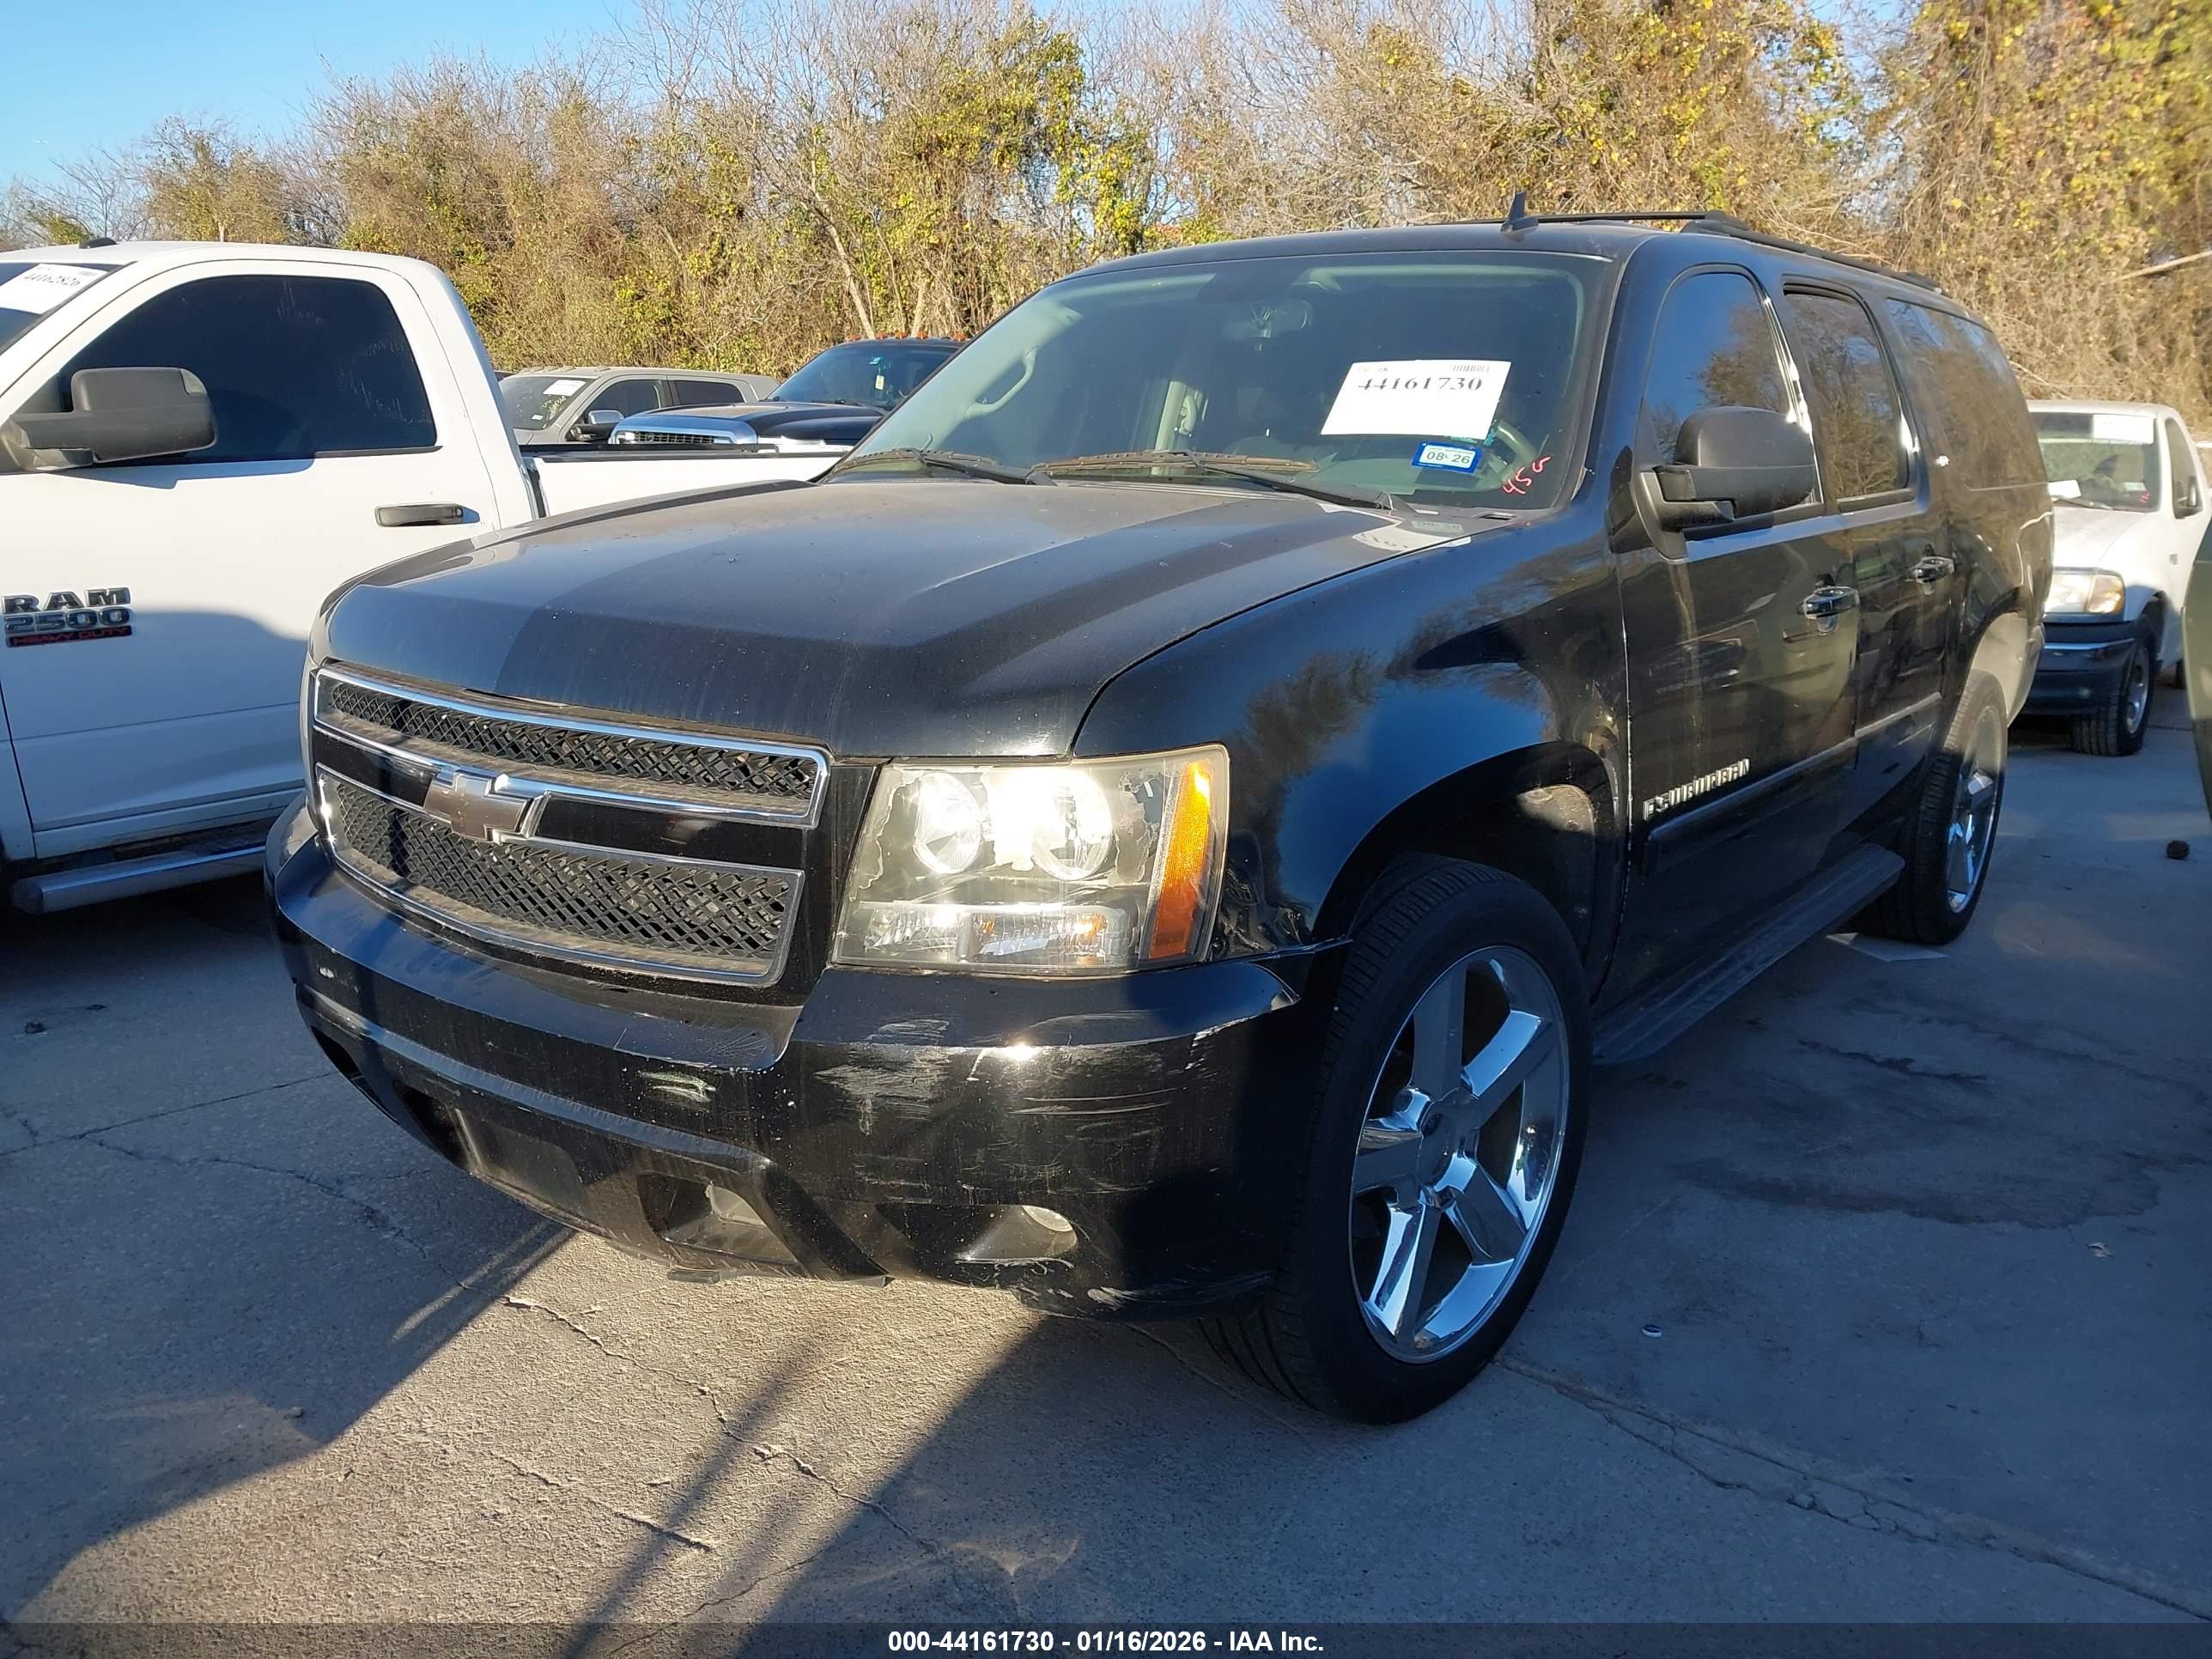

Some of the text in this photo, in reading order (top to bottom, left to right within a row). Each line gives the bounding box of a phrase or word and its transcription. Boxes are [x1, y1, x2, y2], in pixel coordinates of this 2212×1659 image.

[1358, 378, 1482, 391] 44161730
[1426, 451, 1444, 461] 08
[1451, 454, 1471, 465] 26
[1, 587, 131, 614] RAM
[4, 606, 133, 634] 2500
[1643, 758, 1750, 821] SUBURBAN
